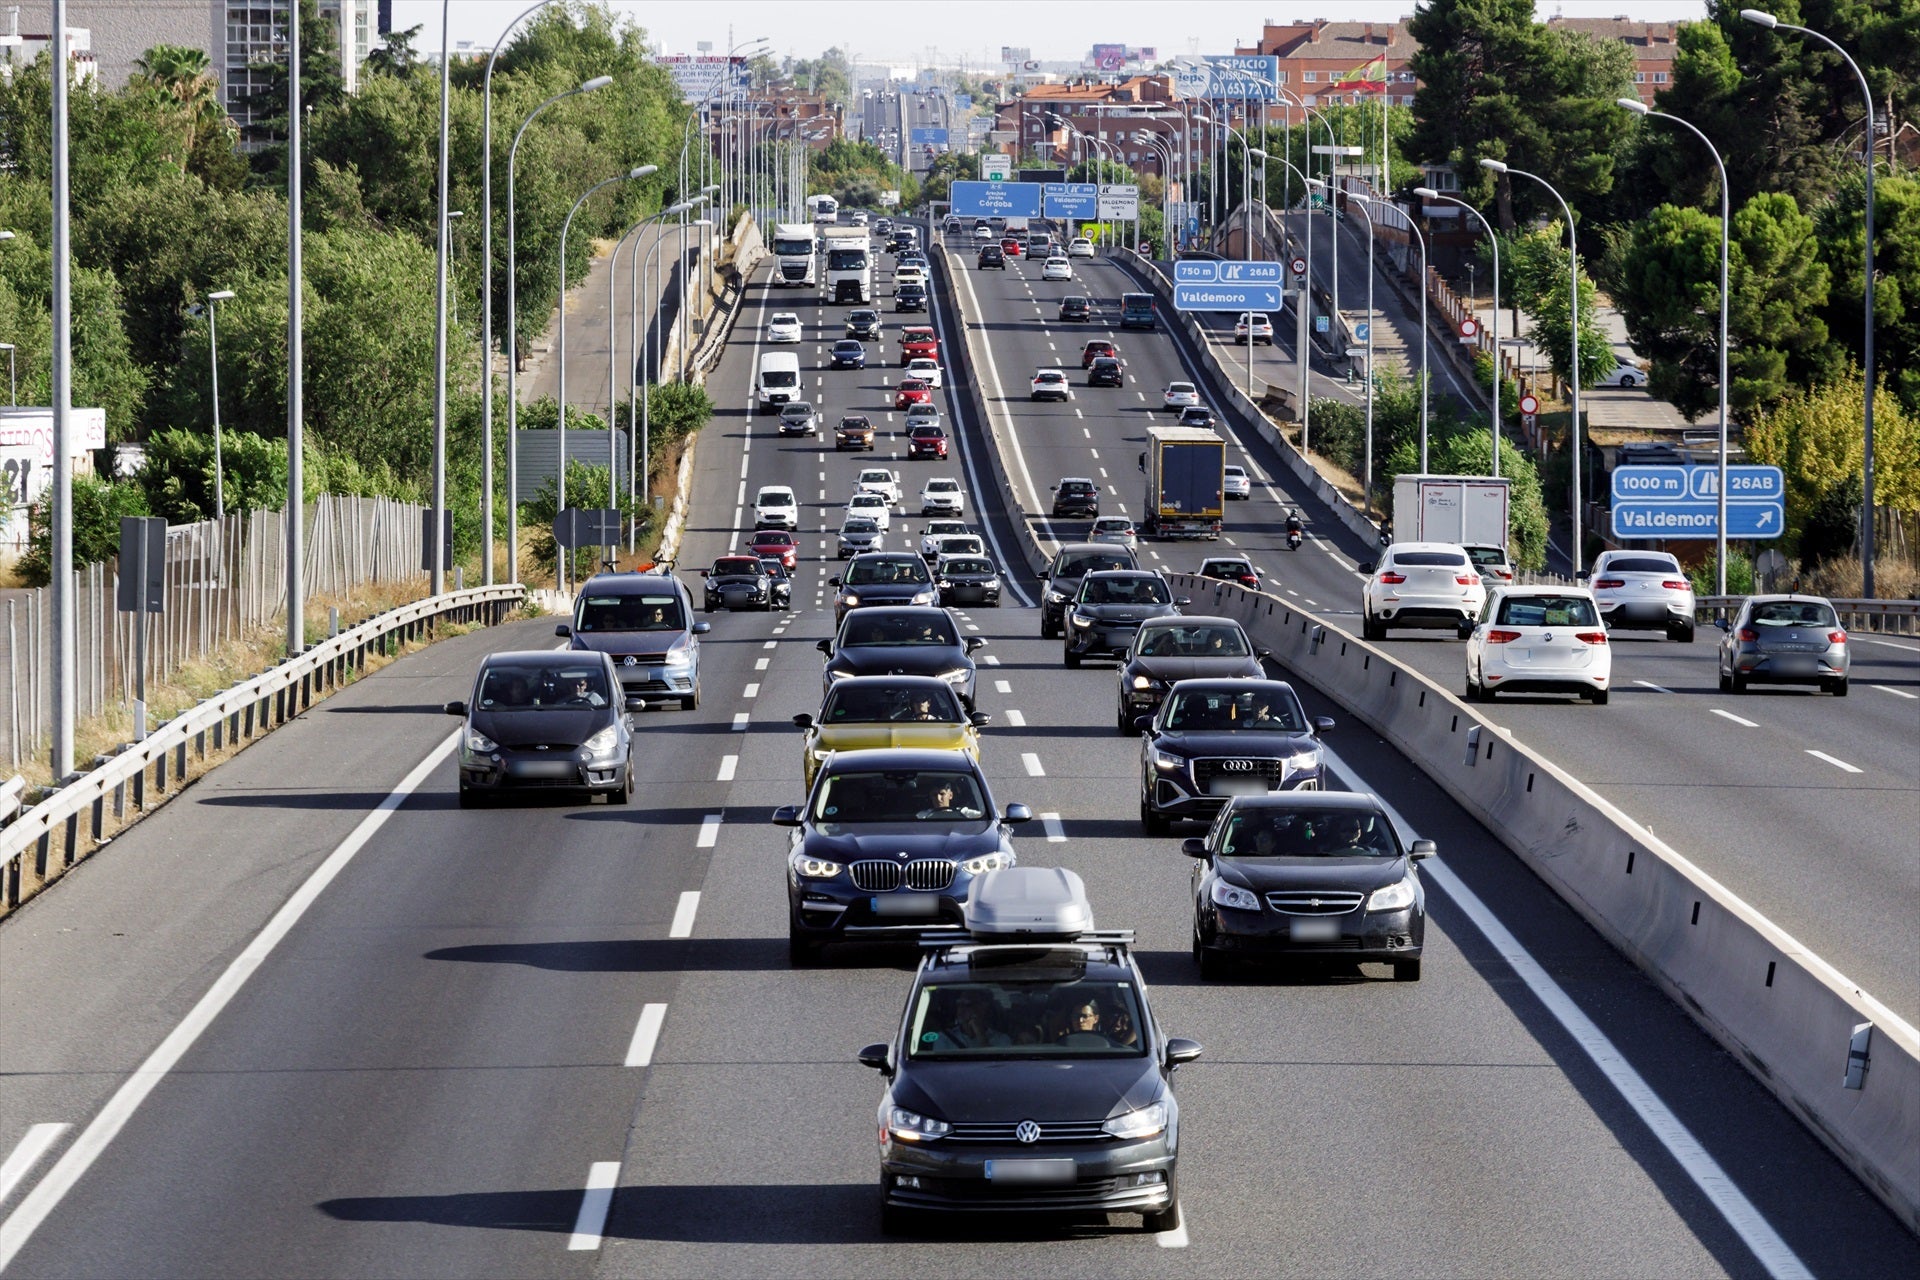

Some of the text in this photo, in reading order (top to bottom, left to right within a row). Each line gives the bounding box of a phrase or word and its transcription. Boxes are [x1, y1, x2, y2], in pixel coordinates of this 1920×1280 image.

[1220, 59, 1268, 69] ESPACIO
[1220, 70, 1267, 80] DISPONBLE
[979, 199, 1013, 207] Córdoba
[1182, 267, 1200, 276] 750
[1250, 268, 1276, 276] 26AB
[1182, 291, 1246, 303] Valdemoro
[1622, 477, 1678, 489] 1000 m
[1732, 477, 1773, 489] 26AB
